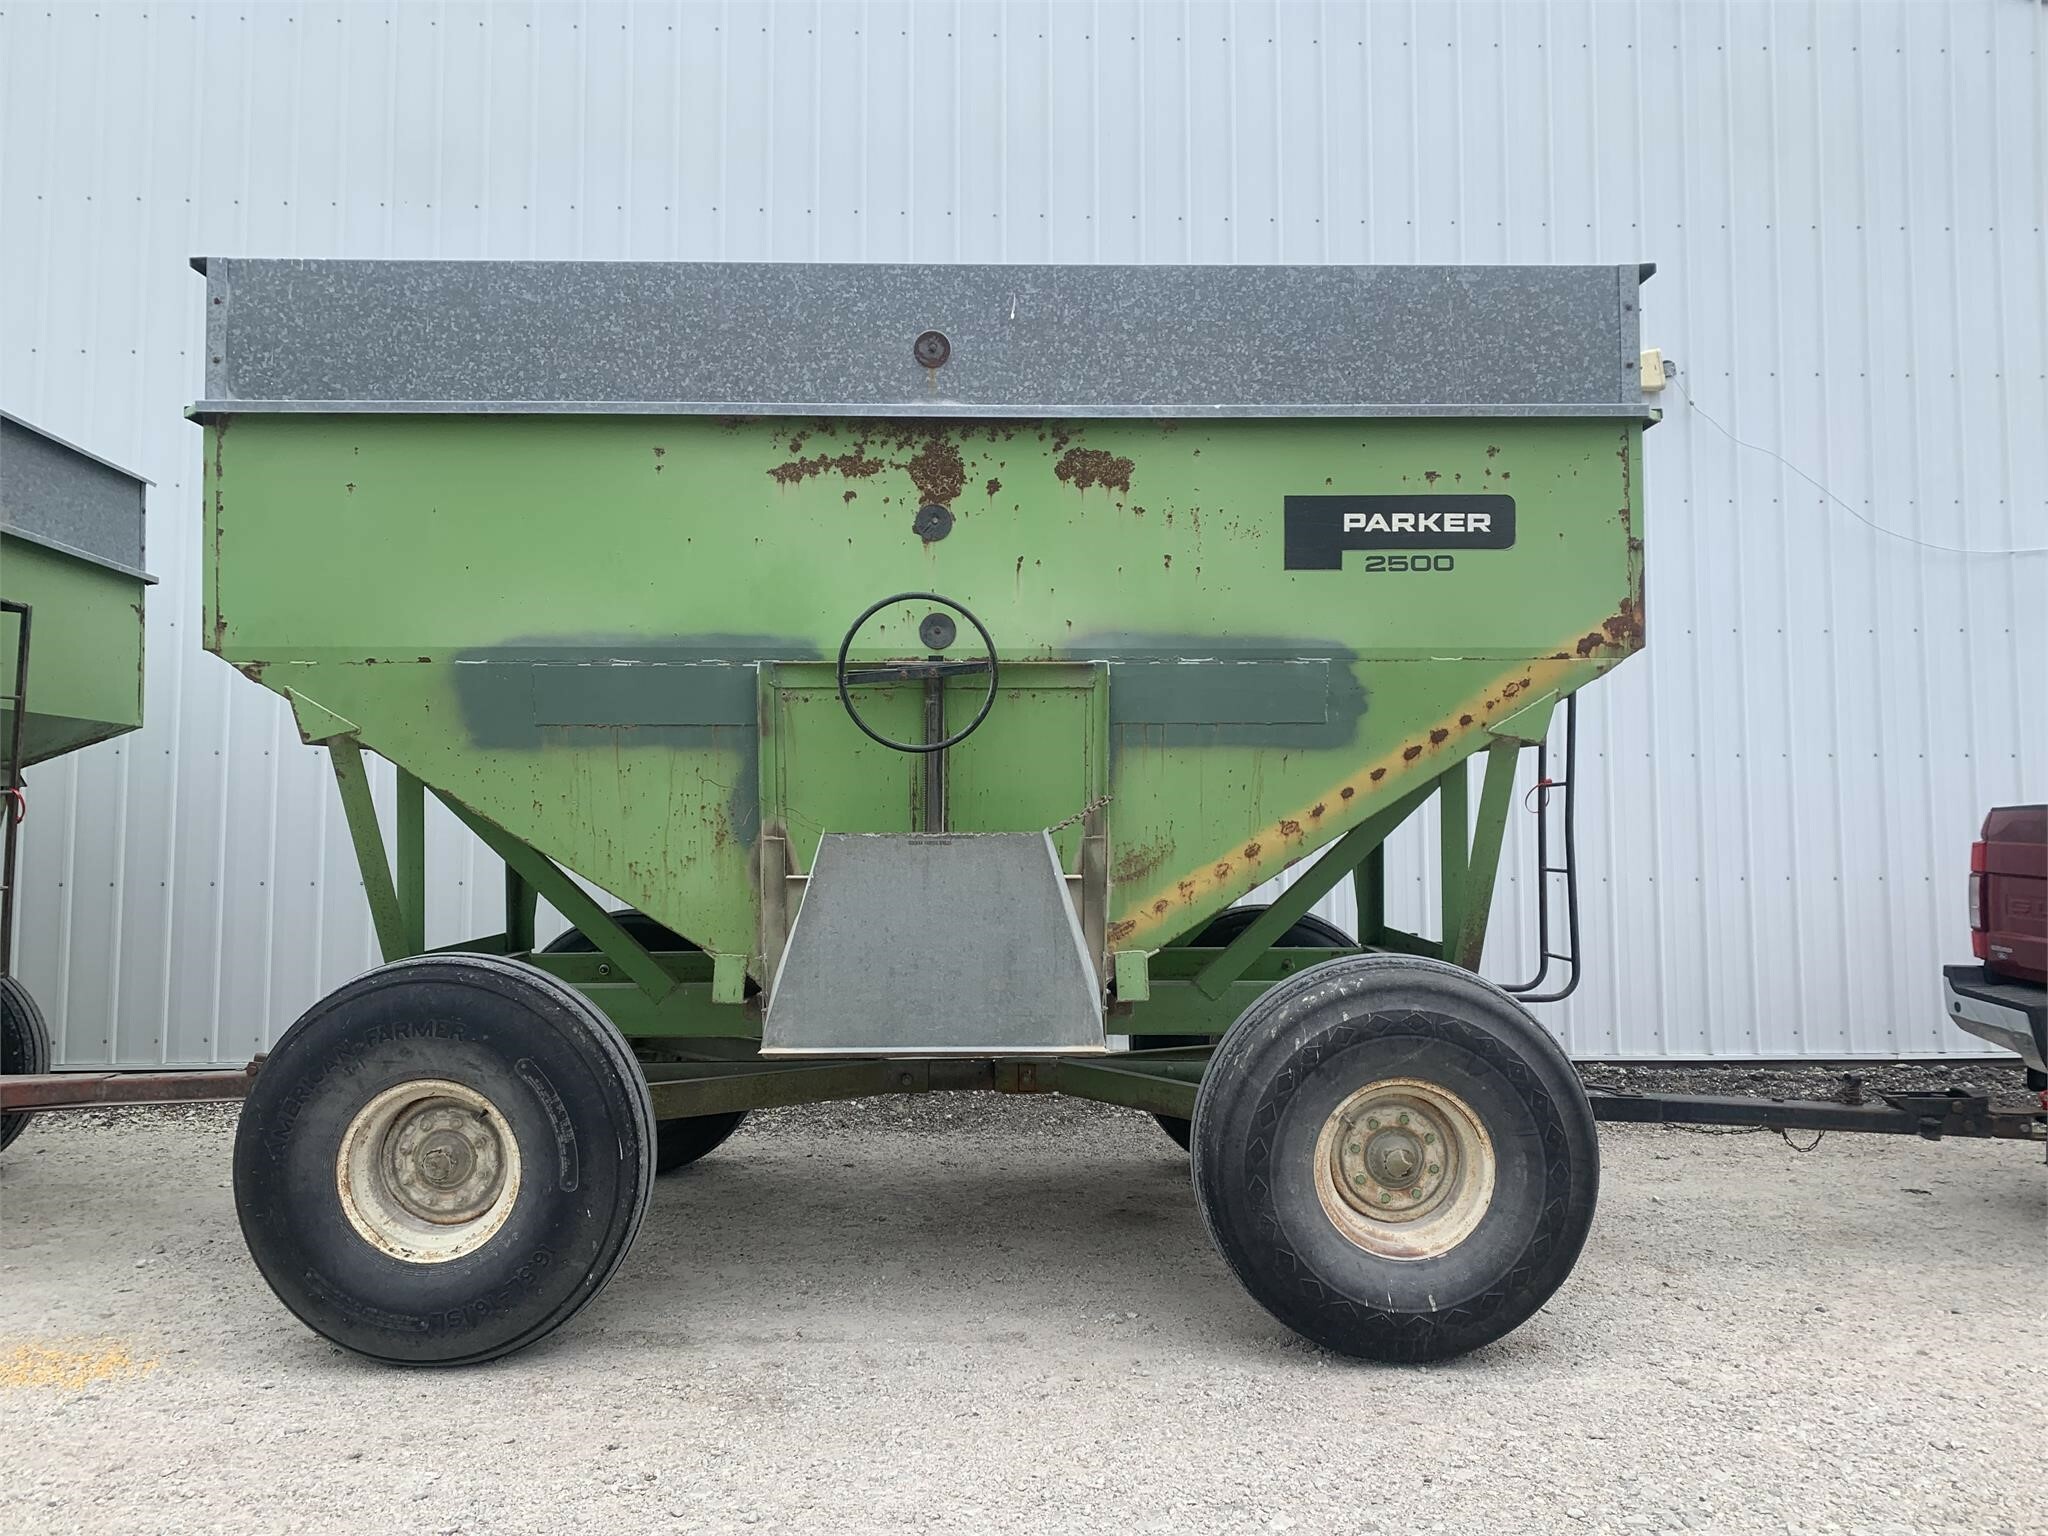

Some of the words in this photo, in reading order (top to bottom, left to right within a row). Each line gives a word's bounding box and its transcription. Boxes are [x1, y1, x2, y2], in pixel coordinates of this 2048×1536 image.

[1343, 512, 1492, 533] PARKER
[1364, 554, 1455, 573] 2500
[271, 1040, 356, 1156] AMERICAN
[363, 1019, 467, 1047] FARMER
